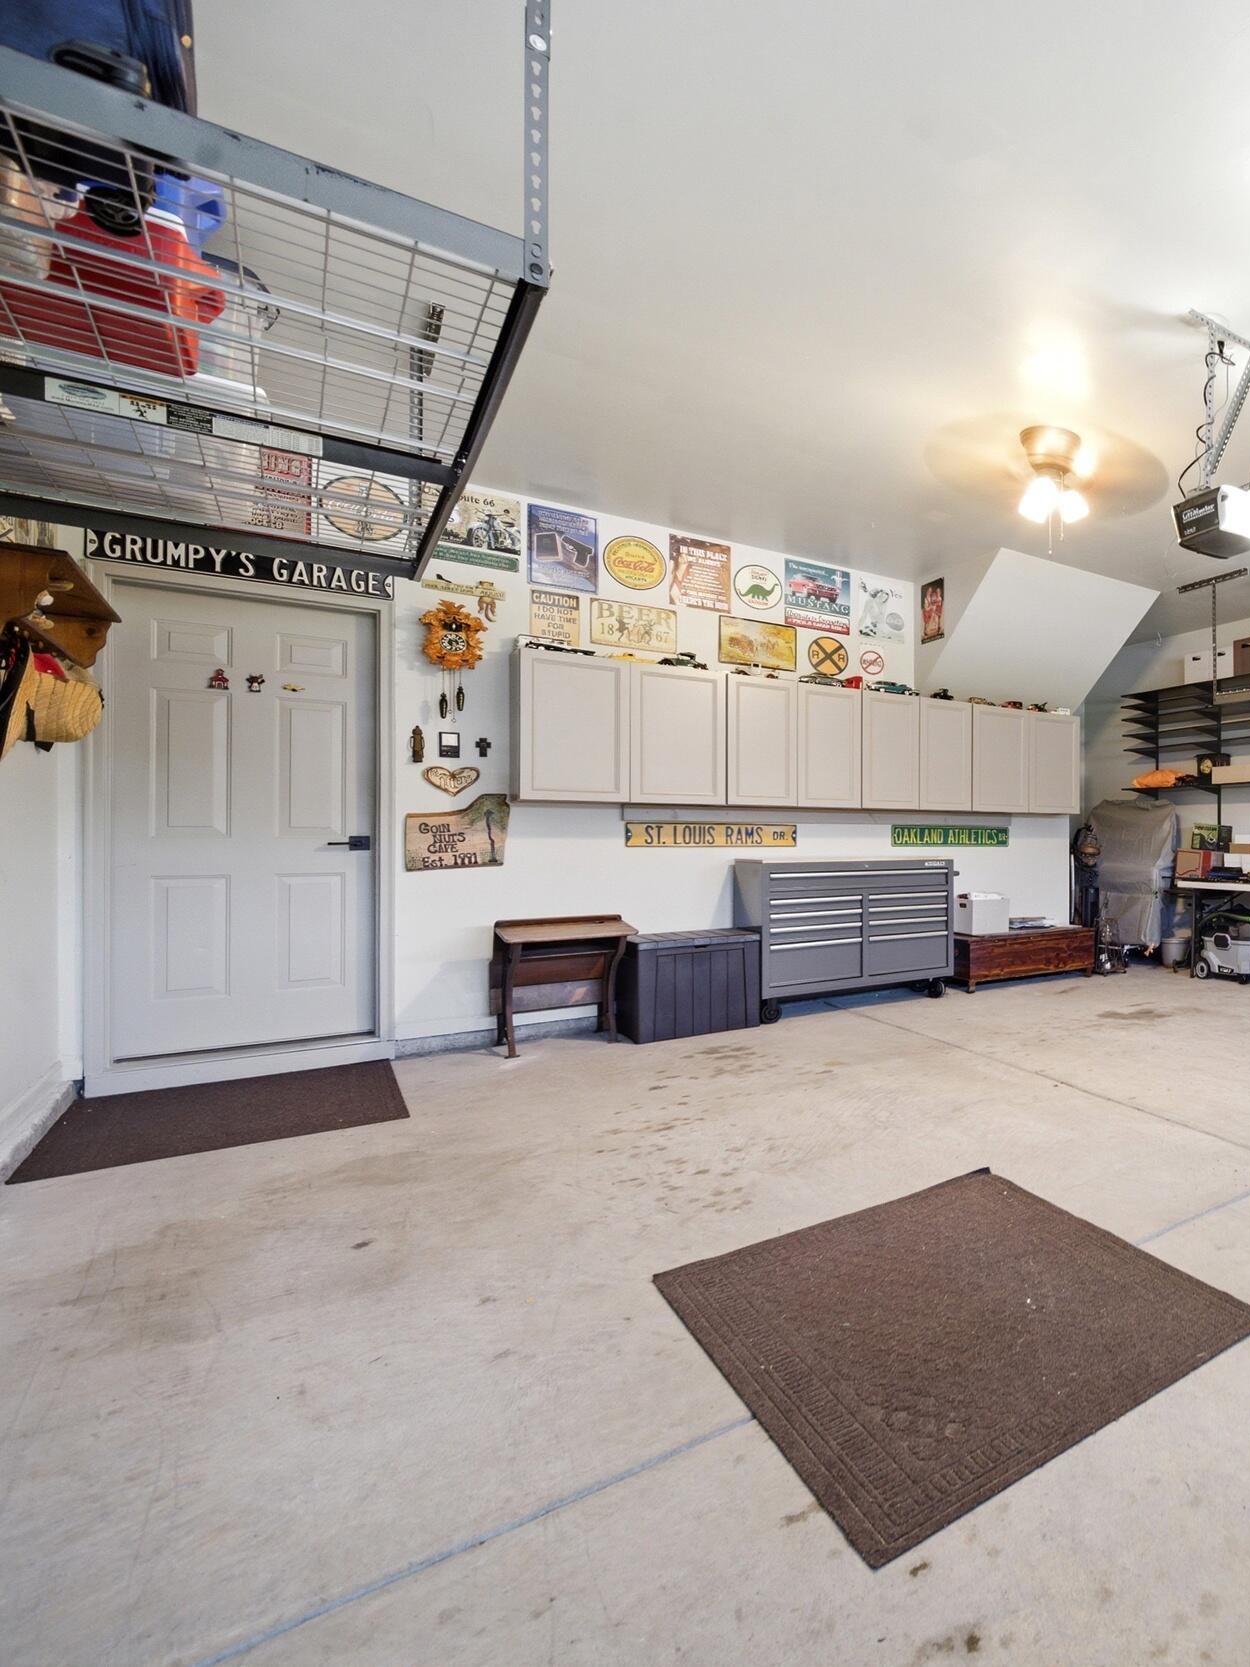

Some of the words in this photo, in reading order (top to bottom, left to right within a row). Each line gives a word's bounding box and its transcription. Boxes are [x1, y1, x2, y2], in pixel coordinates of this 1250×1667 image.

[483, 497, 496, 507] 66
[689, 547, 706, 558] THIS
[707, 550, 728, 562] PLACE
[103, 532, 256, 578] GRUMPY'S
[272, 557, 382, 595] GARAGE
[612, 556, 656, 574] Coca-Cola
[533, 592, 577, 608] CAUTION
[785, 595, 849, 614] MUSTANG
[542, 606, 554, 614] DO
[557, 607, 573, 616] NOT
[596, 601, 673, 631] BEER
[534, 613, 556, 621] HAVE
[558, 616, 577, 625] TIME
[541, 629, 571, 640] STUPID
[600, 622, 615, 636] 18
[655, 631, 670, 643] 67
[811, 649, 820, 659] R
[837, 653, 846, 662] R
[431, 831, 467, 845] NUTS
[644, 825, 666, 845] ST.
[673, 825, 716, 845] LOUIS
[725, 826, 764, 845] RAMS
[772, 830, 789, 841] DR.
[895, 828, 944, 844] OAKLAND
[947, 829, 998, 845] ATHLETICS
[421, 857, 448, 868] Est.
[450, 852, 479, 866] 1991
